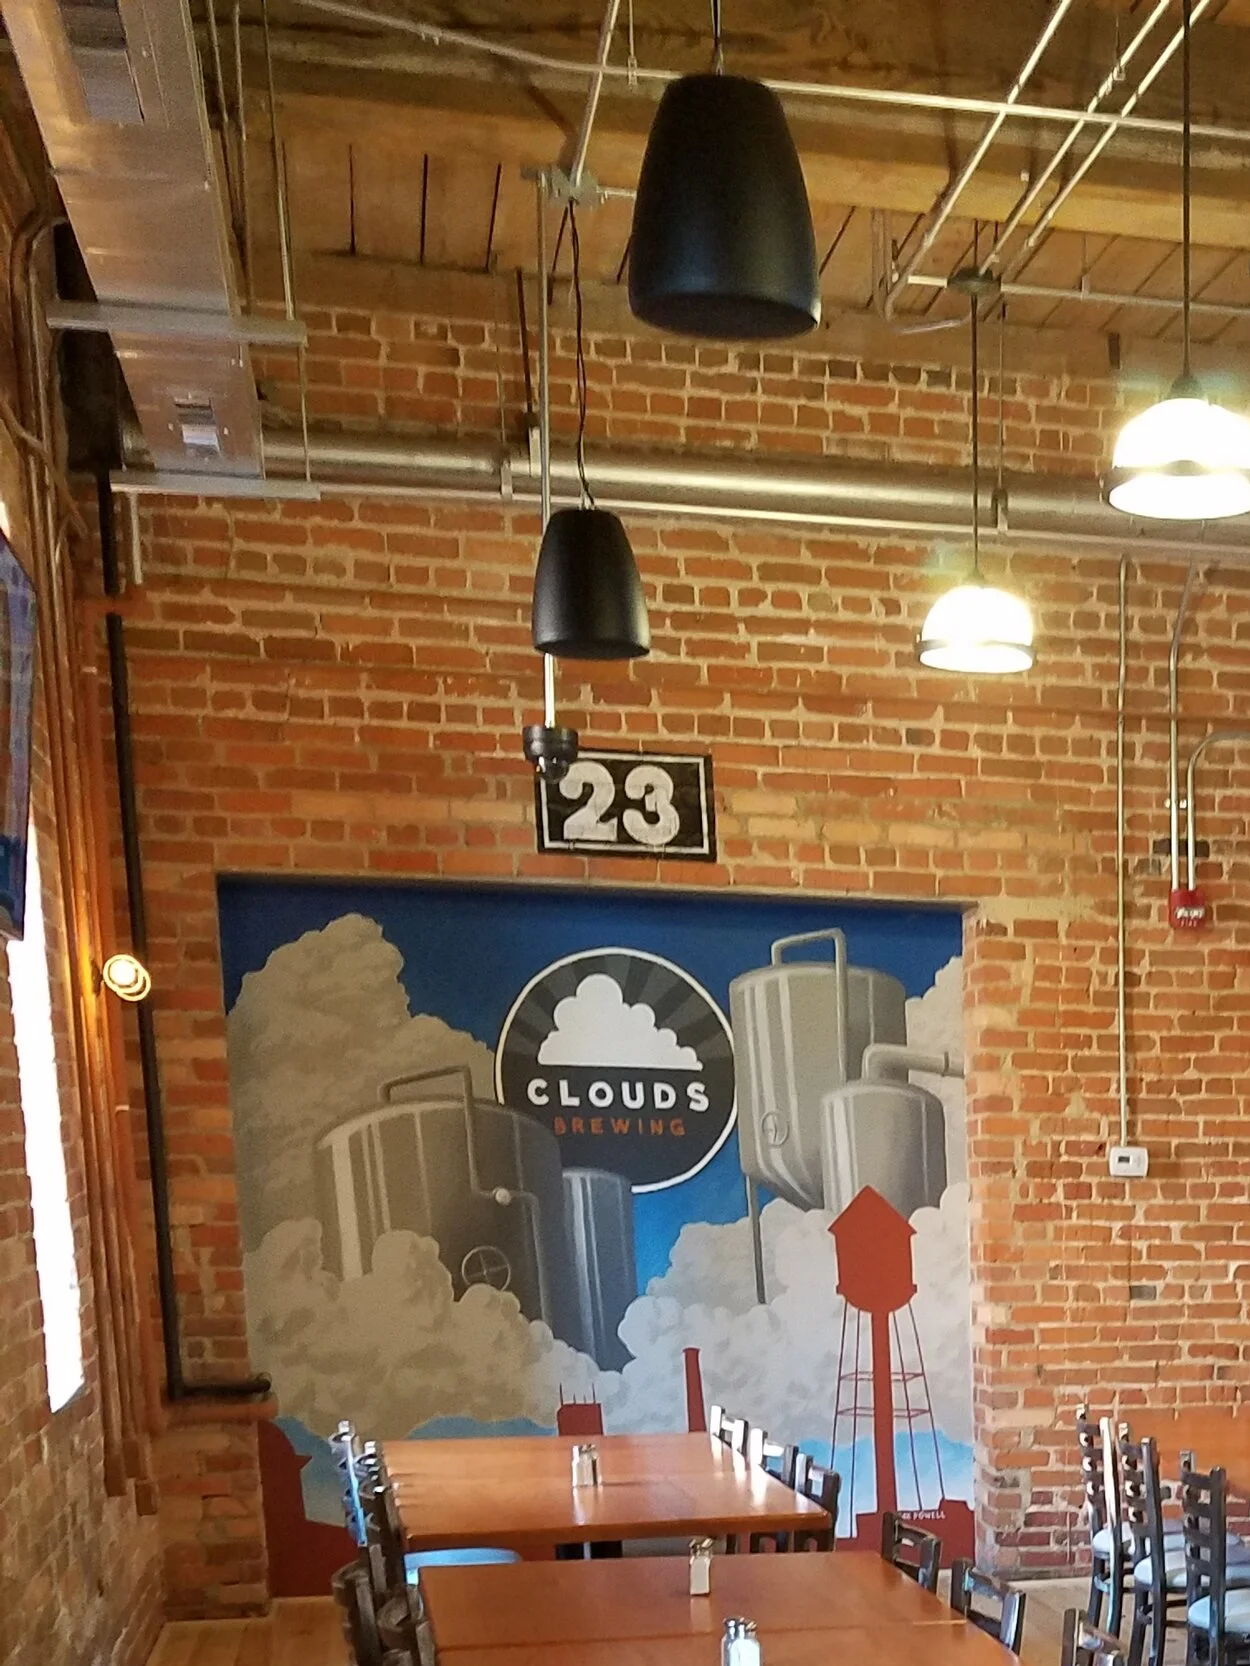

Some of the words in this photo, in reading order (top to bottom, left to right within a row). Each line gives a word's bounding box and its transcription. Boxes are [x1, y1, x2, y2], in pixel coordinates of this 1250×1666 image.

[559, 761, 680, 845] 23
[527, 1077, 710, 1112] CLOUDS
[553, 1115, 686, 1137] BREWING
